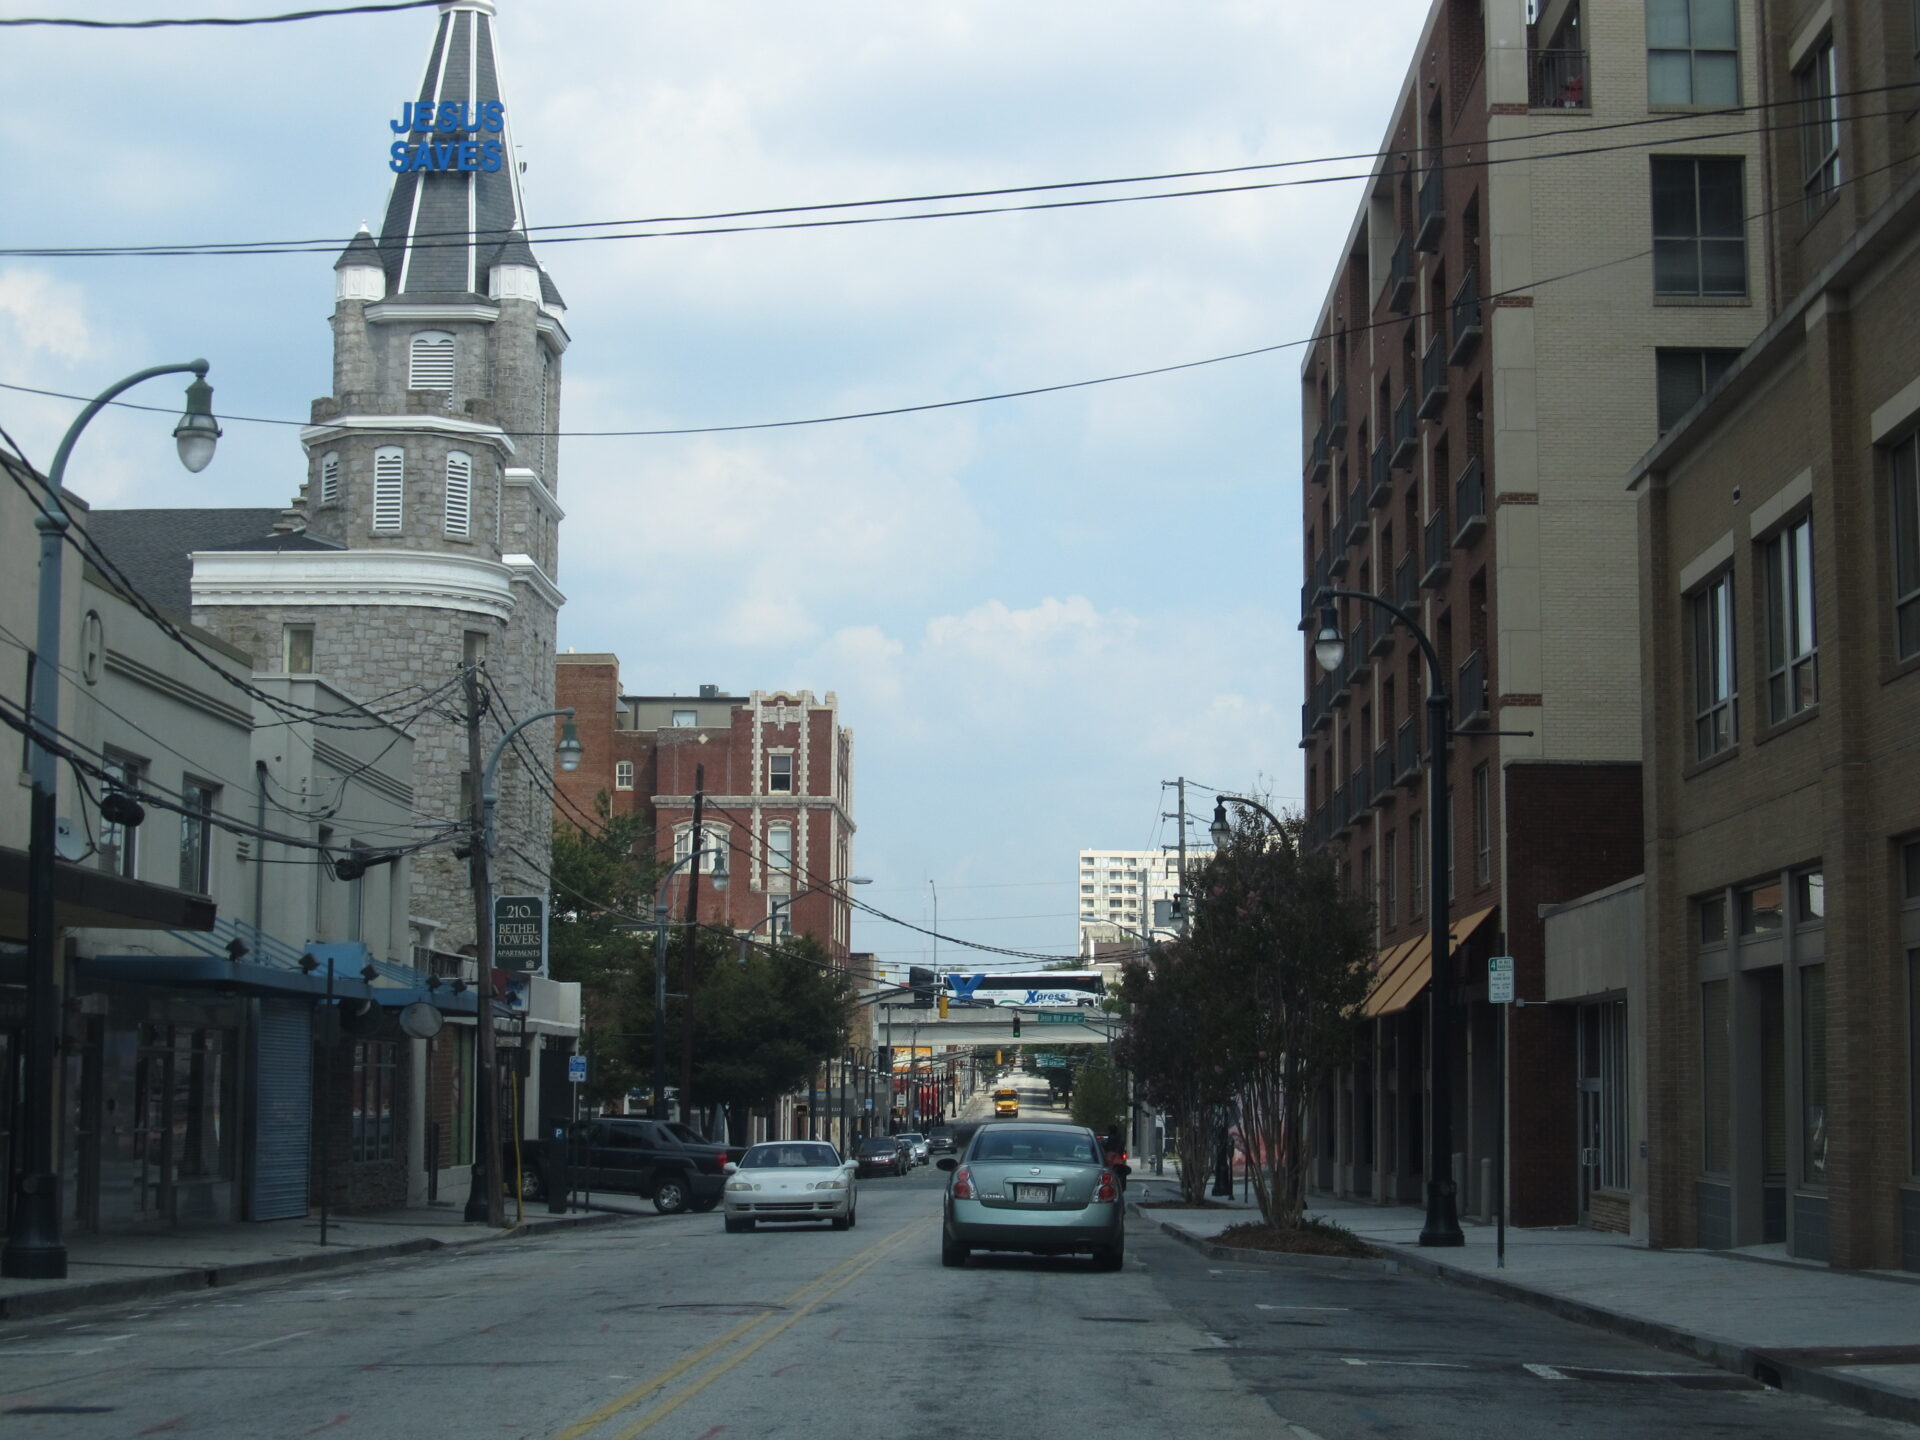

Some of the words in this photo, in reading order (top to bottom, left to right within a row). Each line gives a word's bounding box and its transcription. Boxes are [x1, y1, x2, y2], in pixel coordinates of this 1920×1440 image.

[390, 101, 505, 133] JESUS
[389, 140, 502, 173] SAVES
[506, 905, 531, 919] 210
[499, 923, 539, 934] BETHEL
[497, 934, 541, 945] TOWERS
[497, 949, 541, 958] APARTMENTS
[1491, 960, 1496, 970] 4
[1025, 990, 1067, 1004] Xpress
